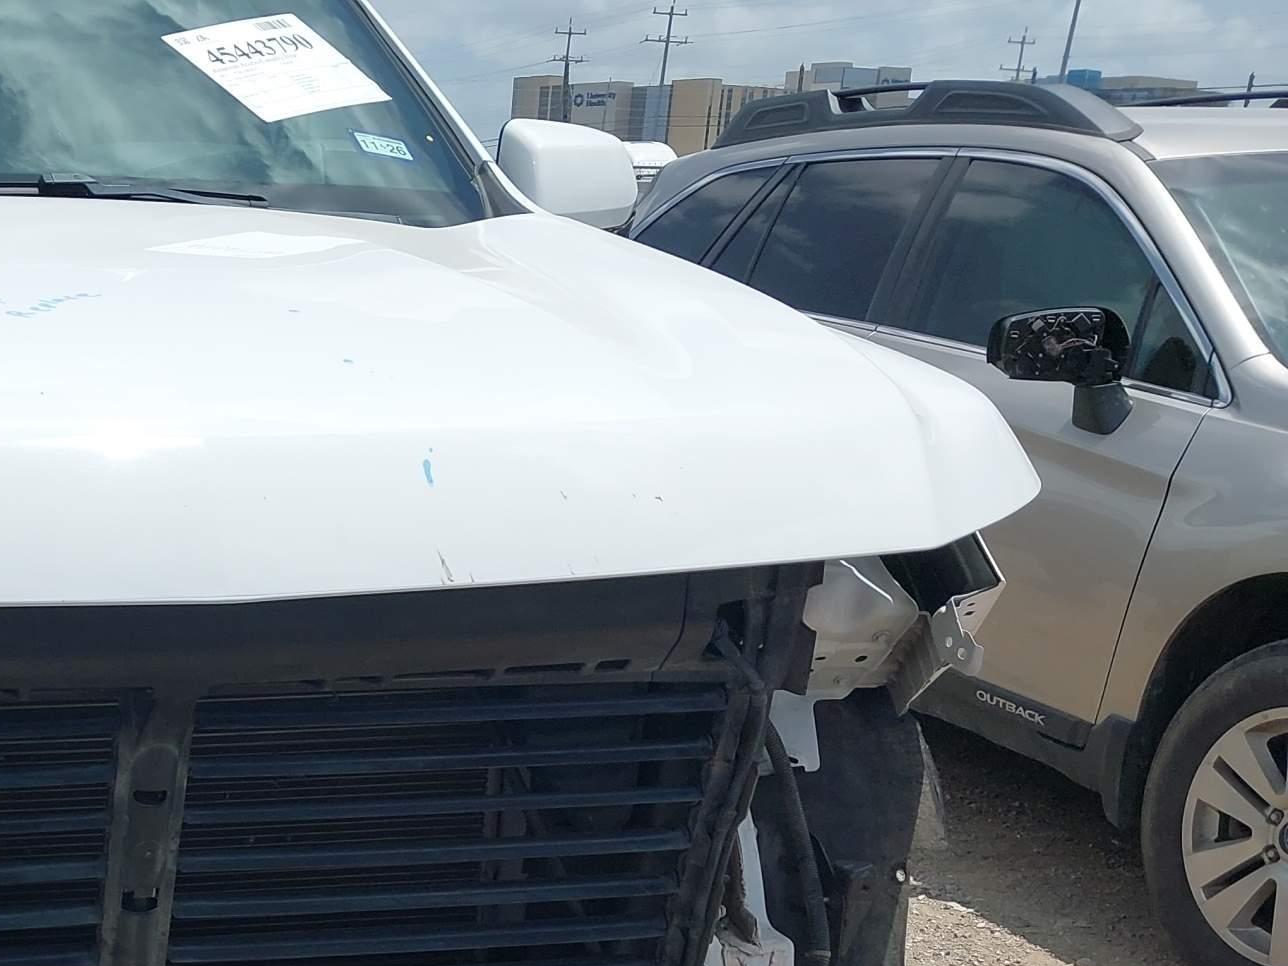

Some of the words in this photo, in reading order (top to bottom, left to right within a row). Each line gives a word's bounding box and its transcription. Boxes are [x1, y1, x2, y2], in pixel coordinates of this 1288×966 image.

[206, 33, 314, 65] 45443790
[586, 98, 607, 107] Health
[975, 690, 1047, 726] OUTBACK
